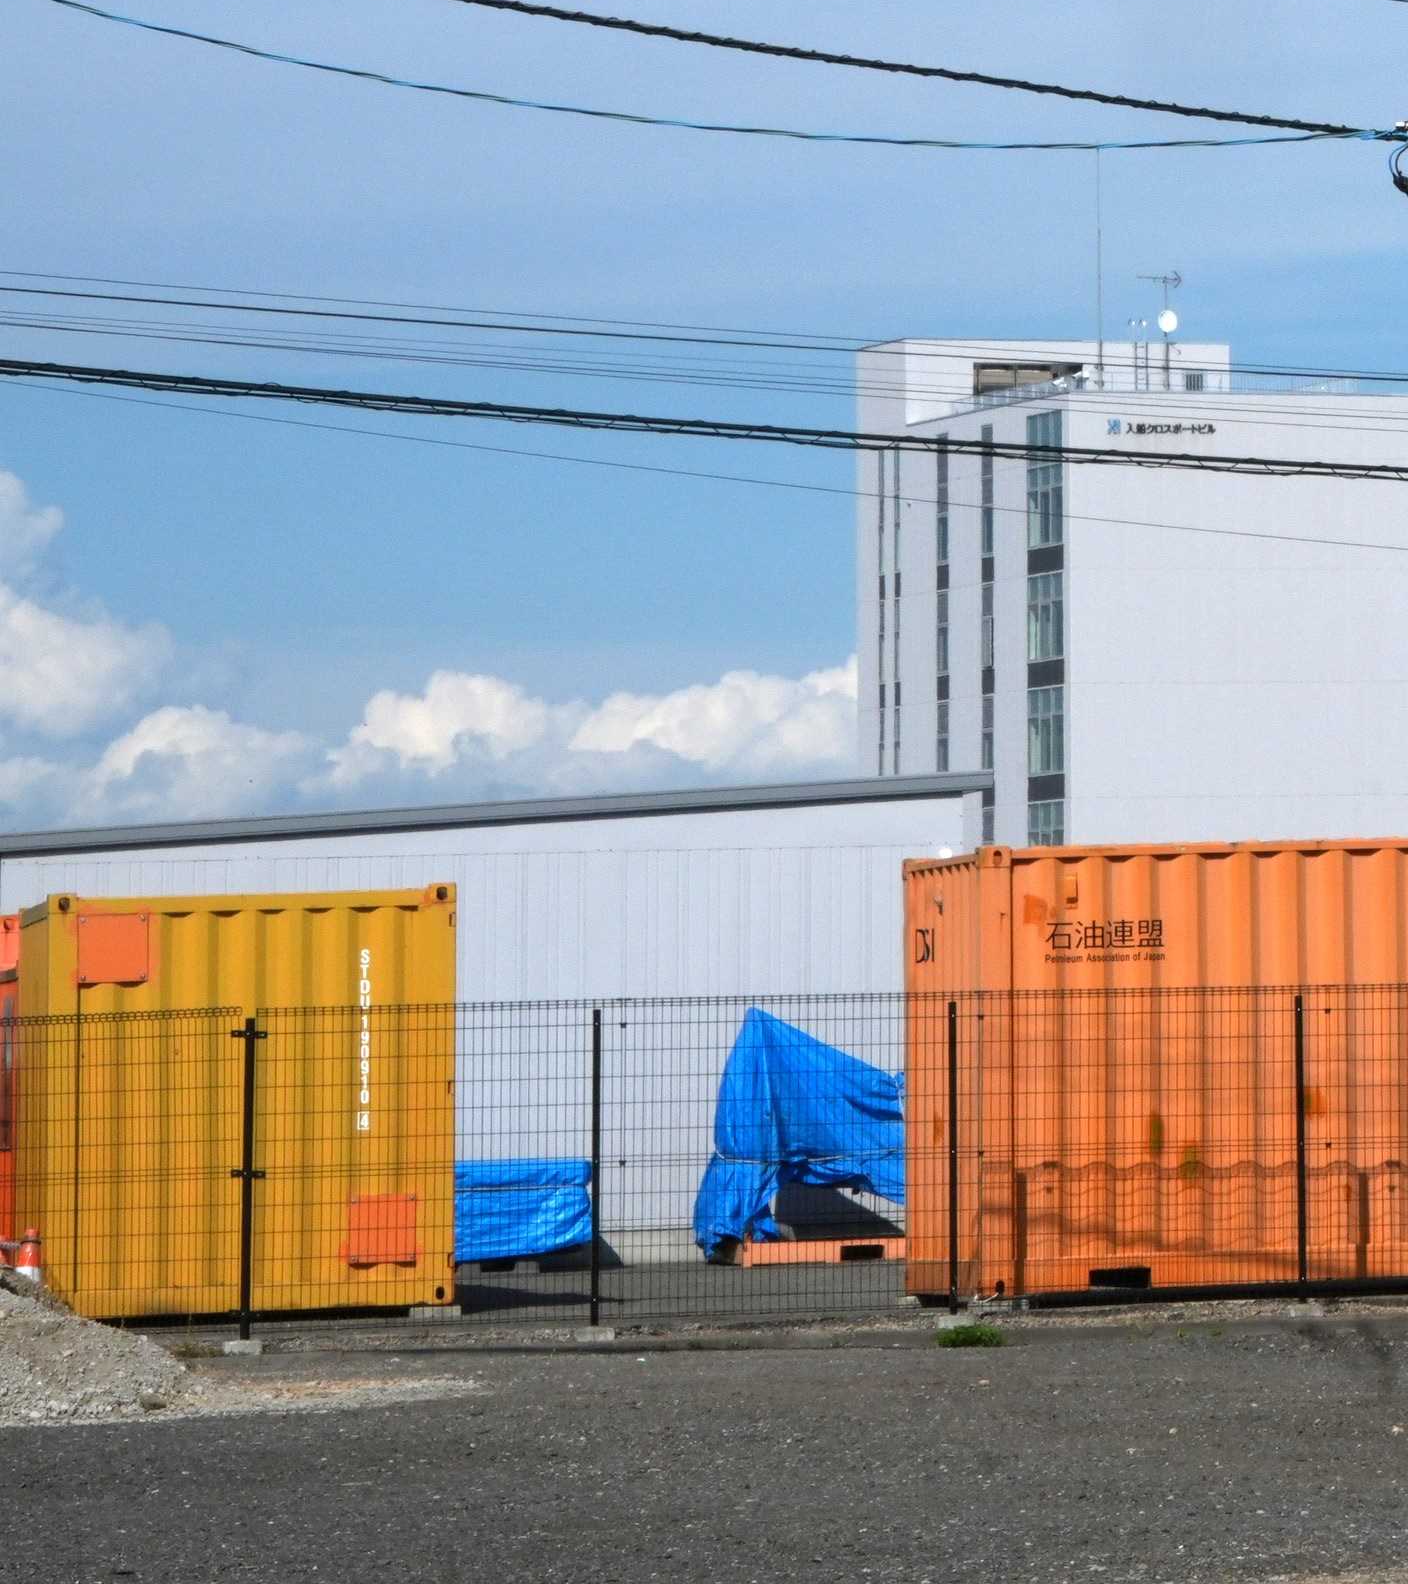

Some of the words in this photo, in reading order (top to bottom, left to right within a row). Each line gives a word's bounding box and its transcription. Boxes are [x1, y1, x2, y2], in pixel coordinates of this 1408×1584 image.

[1045, 919, 1165, 950] 石油連盟
[1086, 952, 1130, 962] Association
[1132, 952, 1141, 961] of
[1143, 952, 1166, 961] Japan
